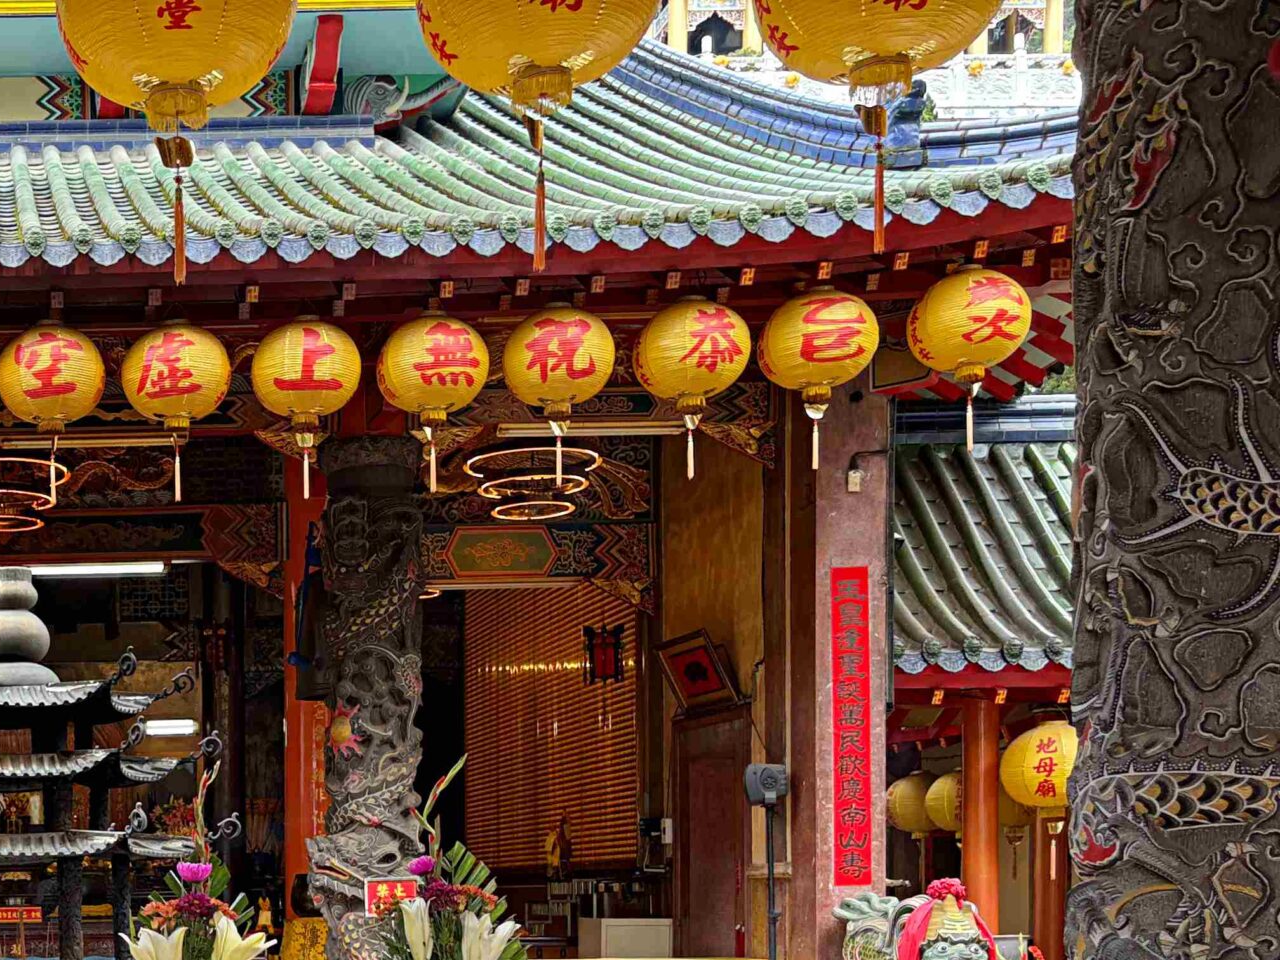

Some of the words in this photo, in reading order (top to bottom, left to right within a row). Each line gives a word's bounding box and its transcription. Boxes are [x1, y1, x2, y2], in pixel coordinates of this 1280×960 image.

[14, 332, 84, 399] 空
[273, 327, 344, 391] 上
[413, 322, 481, 387] 無
[525, 318, 596, 384] 祝
[679, 307, 744, 373] 恭
[1033, 737, 1058, 798] 地母廟
